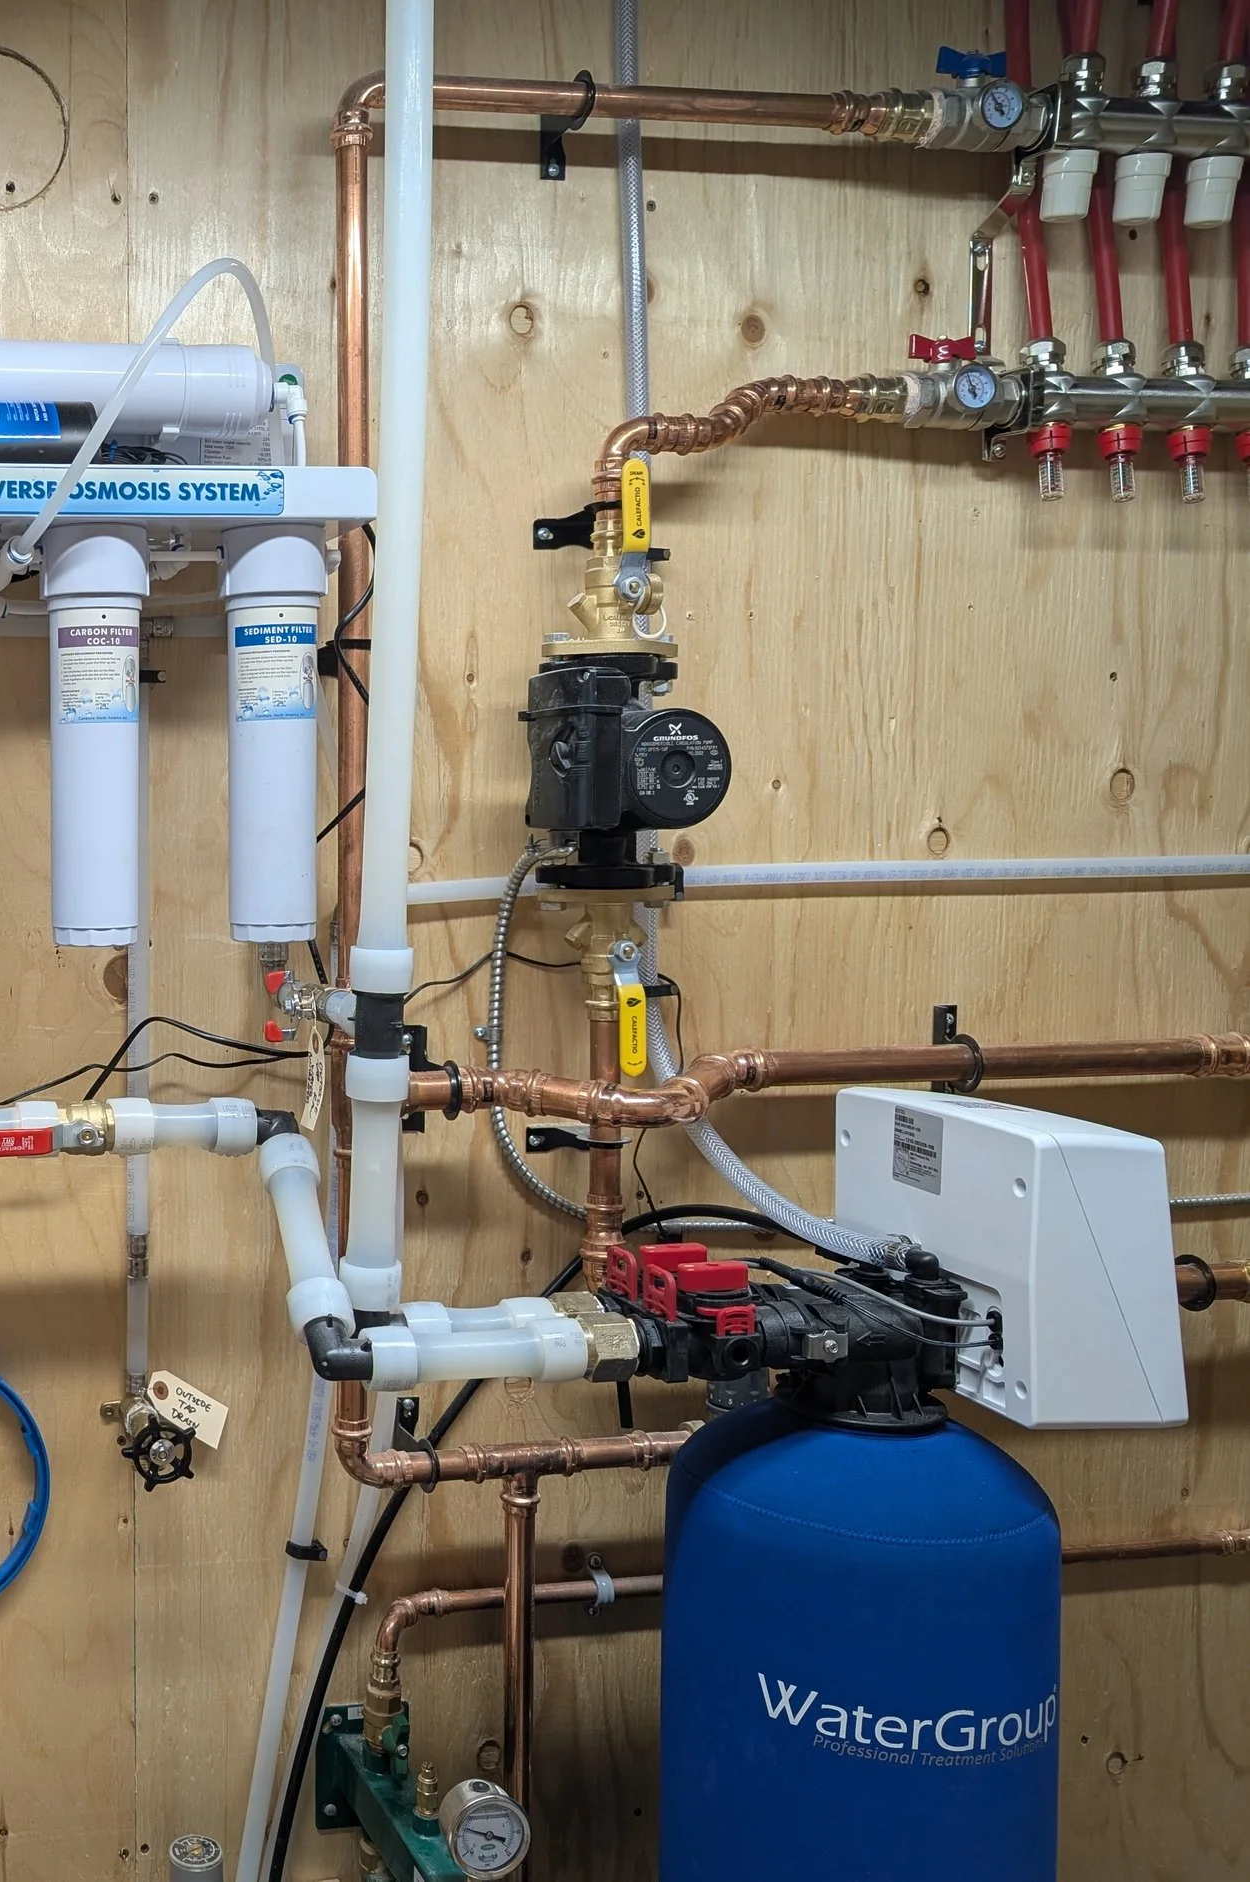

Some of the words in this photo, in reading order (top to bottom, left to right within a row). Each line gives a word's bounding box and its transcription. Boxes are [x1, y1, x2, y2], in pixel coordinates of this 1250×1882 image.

[177, 481, 260, 502] SYSTEM
[634, 486, 642, 527] CALEFACTIO
[70, 628, 108, 637] CARBON
[110, 628, 133, 637] FILTER
[87, 637, 120, 645] COC-10
[244, 626, 289, 636] SEDIMENT
[291, 626, 312, 634] FILTER
[265, 636, 297, 644] SED-10
[175, 1387, 212, 1413] OUTSIDE
[178, 1399, 197, 1414] TAP
[171, 1408, 201, 1429] DRAIN
[757, 1671, 1056, 1752] WaterGroup
[813, 1734, 914, 1764] Professional
[921, 1750, 996, 1766] Treatment
